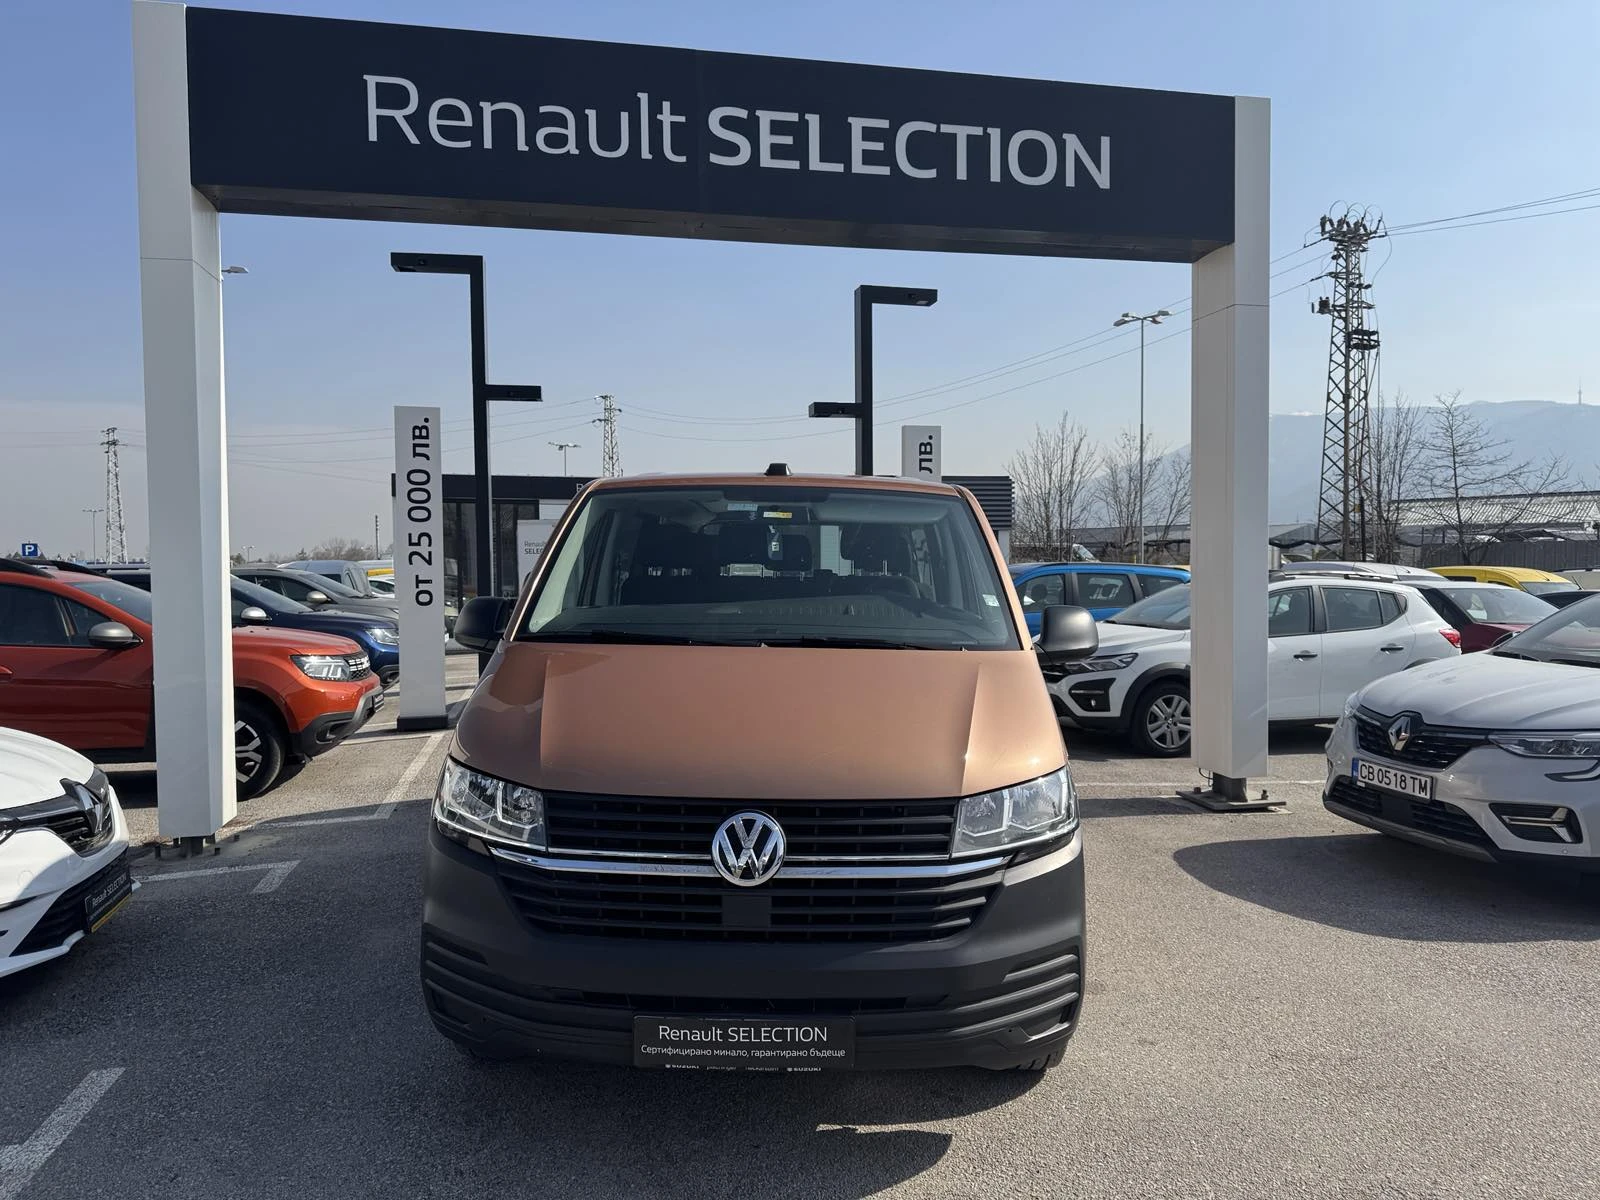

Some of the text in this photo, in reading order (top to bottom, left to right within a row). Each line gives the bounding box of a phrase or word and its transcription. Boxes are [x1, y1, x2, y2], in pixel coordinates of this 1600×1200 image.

[363, 74, 1111, 189] Renault SELECTION
[406, 468, 432, 523] 000
[408, 531, 433, 566] 25
[415, 574, 434, 607] от
[1360, 764, 1428, 797] CB 0518 TM
[658, 1025, 827, 1042] Renault SELECTION
[640, 1044, 712, 1056] Сертифицирано
[750, 1049, 808, 1059] гарантирано
[809, 1048, 846, 1059] бъдеще
